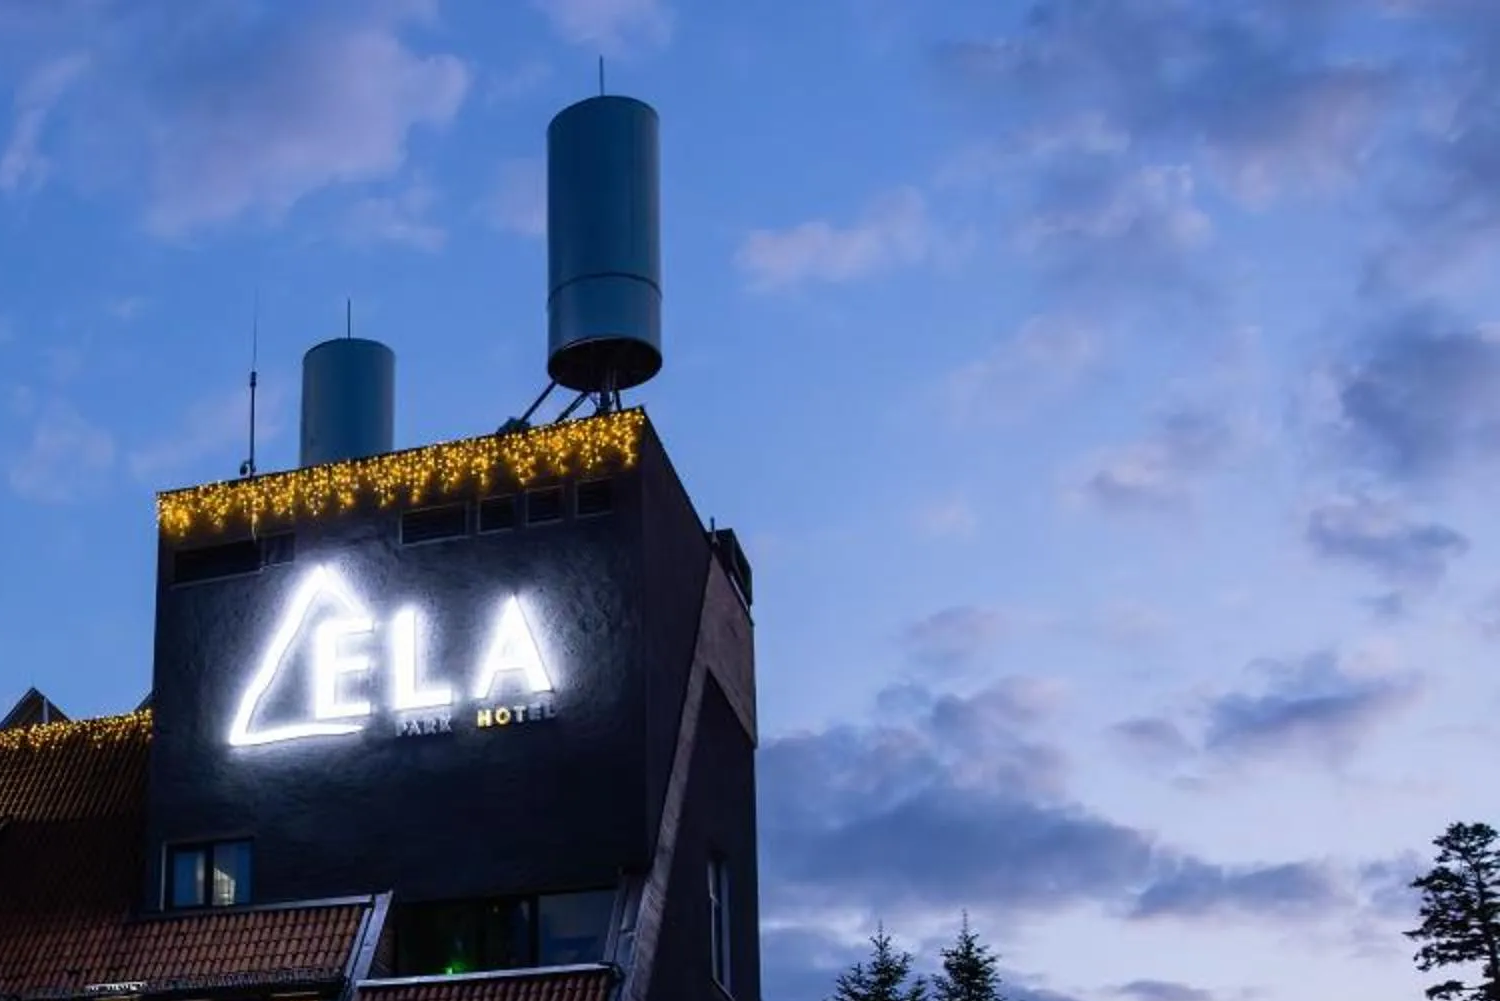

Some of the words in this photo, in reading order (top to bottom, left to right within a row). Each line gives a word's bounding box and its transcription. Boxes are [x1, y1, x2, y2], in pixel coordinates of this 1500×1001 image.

[313, 593, 556, 721] ELA
[394, 714, 454, 738] PARK
[475, 701, 558, 728] HOTEL
